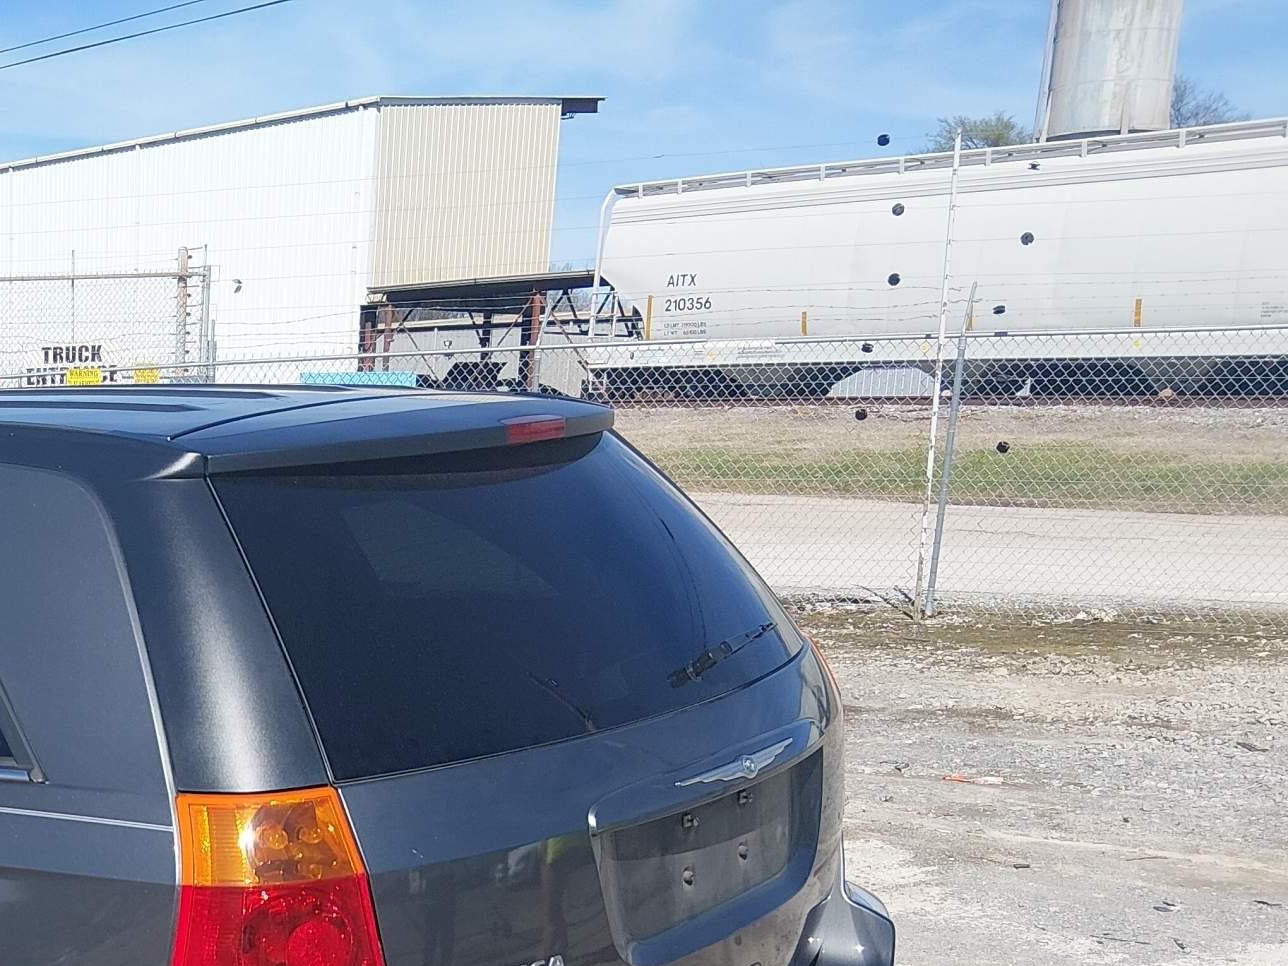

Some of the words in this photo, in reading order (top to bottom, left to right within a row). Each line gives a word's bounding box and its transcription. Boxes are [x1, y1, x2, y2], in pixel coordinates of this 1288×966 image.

[667, 273, 697, 288] AITX
[665, 296, 712, 312] 210356
[41, 345, 102, 364] TRUCK
[69, 370, 99, 378] WARNING
